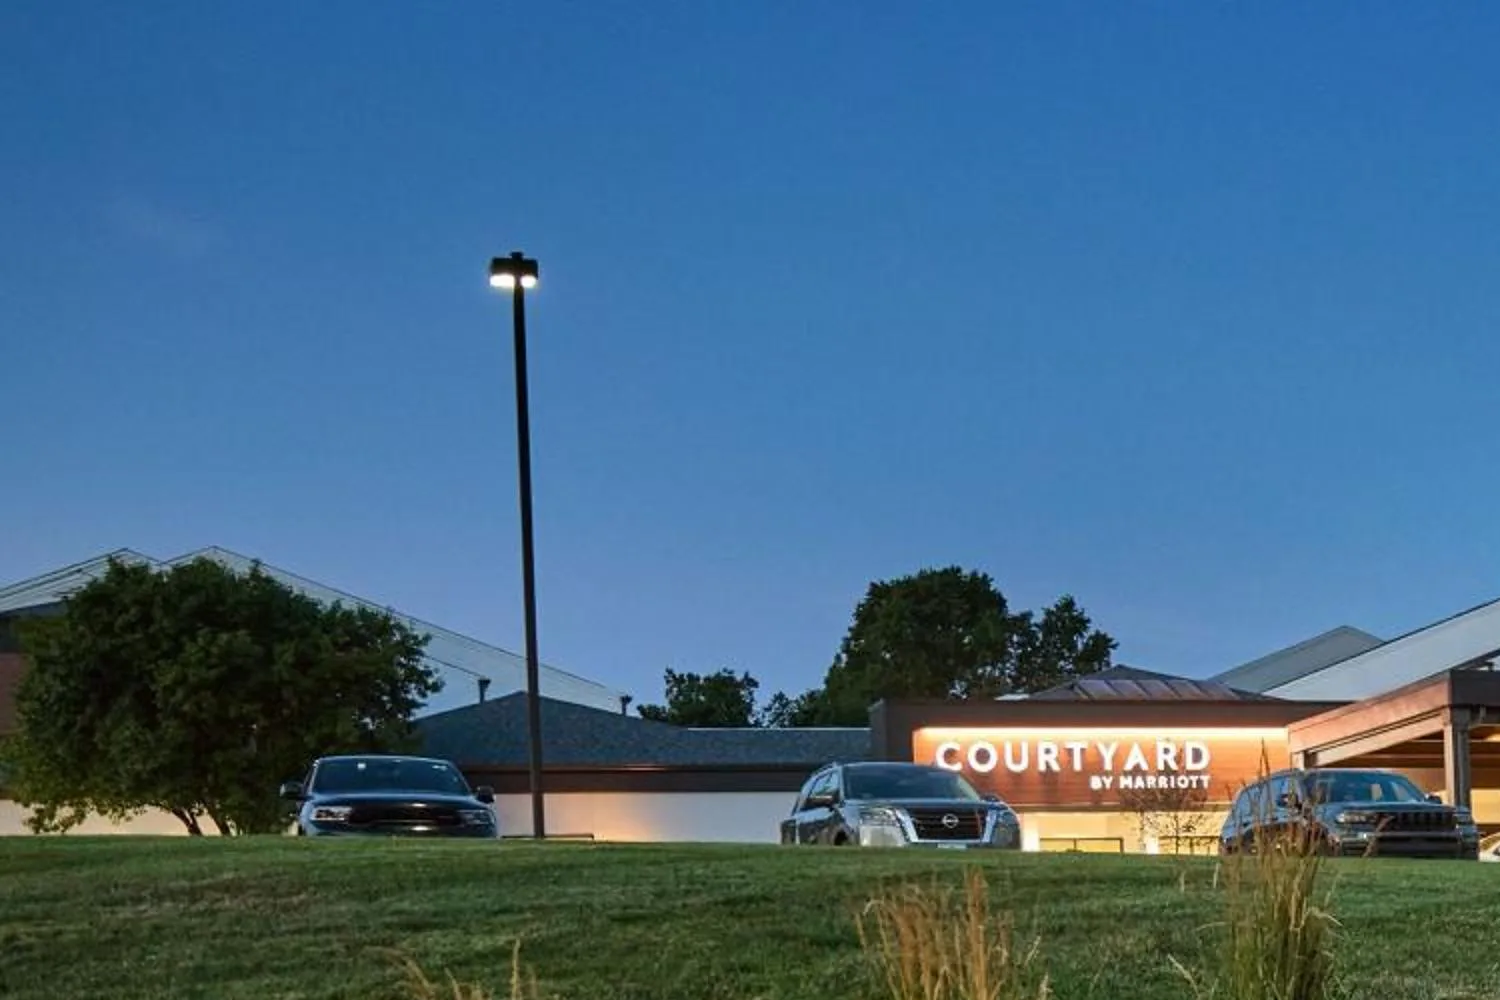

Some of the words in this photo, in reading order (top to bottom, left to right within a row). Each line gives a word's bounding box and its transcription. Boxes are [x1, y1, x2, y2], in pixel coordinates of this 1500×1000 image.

[935, 739, 1211, 773] COURTYARD
[1090, 775, 1114, 790] BY
[1119, 775, 1211, 789] MARRIOTT
